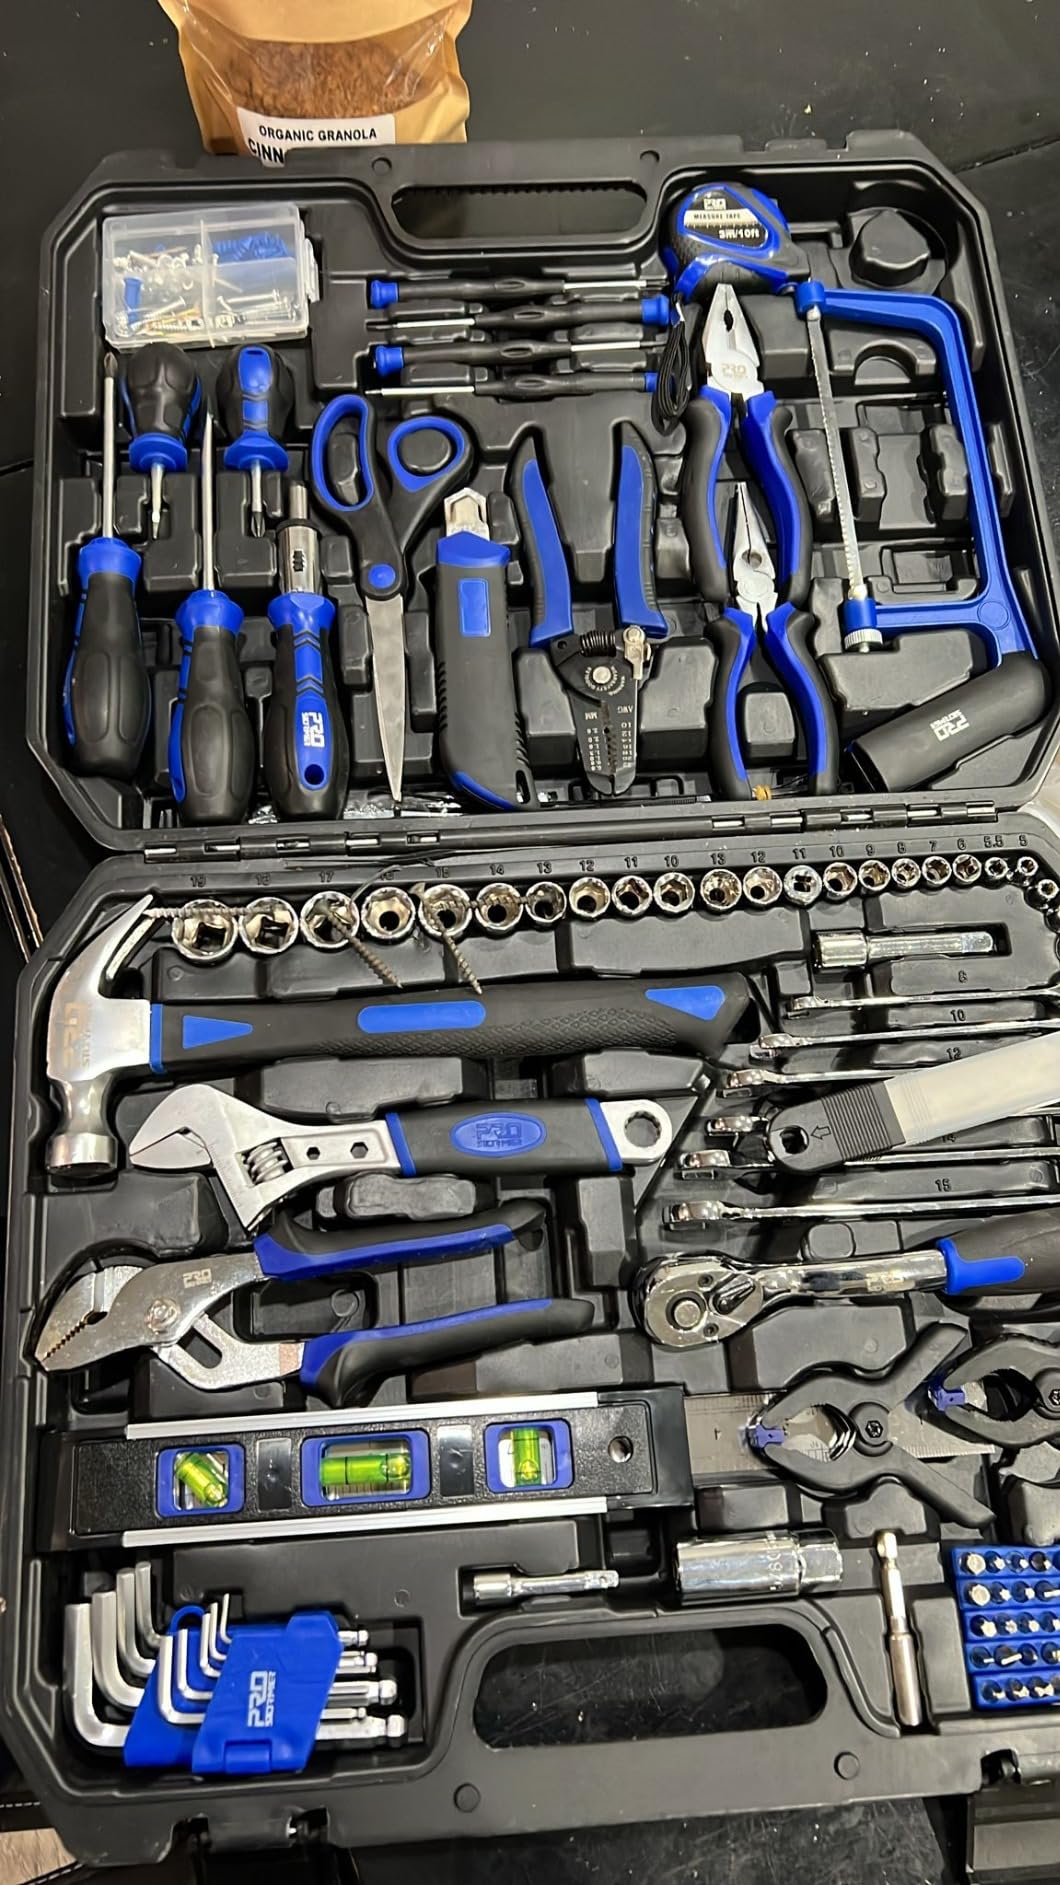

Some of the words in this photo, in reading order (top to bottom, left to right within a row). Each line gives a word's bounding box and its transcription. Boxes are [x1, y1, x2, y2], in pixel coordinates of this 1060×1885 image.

[259, 125, 314, 141] ORGANIC
[318, 128, 377, 141] GRANOLA
[248, 138, 285, 163] CINN
[719, 228, 760, 239] 3m/10ft
[584, 711, 598, 720] MM
[617, 704, 634, 714] AWG
[309, 711, 325, 748] PRO
[929, 840, 938, 852] 7
[956, 838, 967, 850] 6
[983, 835, 1004, 848] 5.5
[1018, 834, 1028, 847] 5
[751, 851, 766, 863] 12
[792, 847, 807, 860] 11
[829, 846, 845, 858] 10
[579, 860, 595, 872] 12
[624, 856, 638, 869] 11
[664, 855, 680, 868] 10
[710, 853, 726, 866] 13
[489, 864, 505, 876] 14
[537, 862, 553, 874] 13
[319, 871, 335, 884] 17
[950, 1008, 966, 1022] 10
[946, 1047, 962, 1061] 12
[935, 1178, 951, 1192] 15
[248, 1670, 268, 1727] PRO
